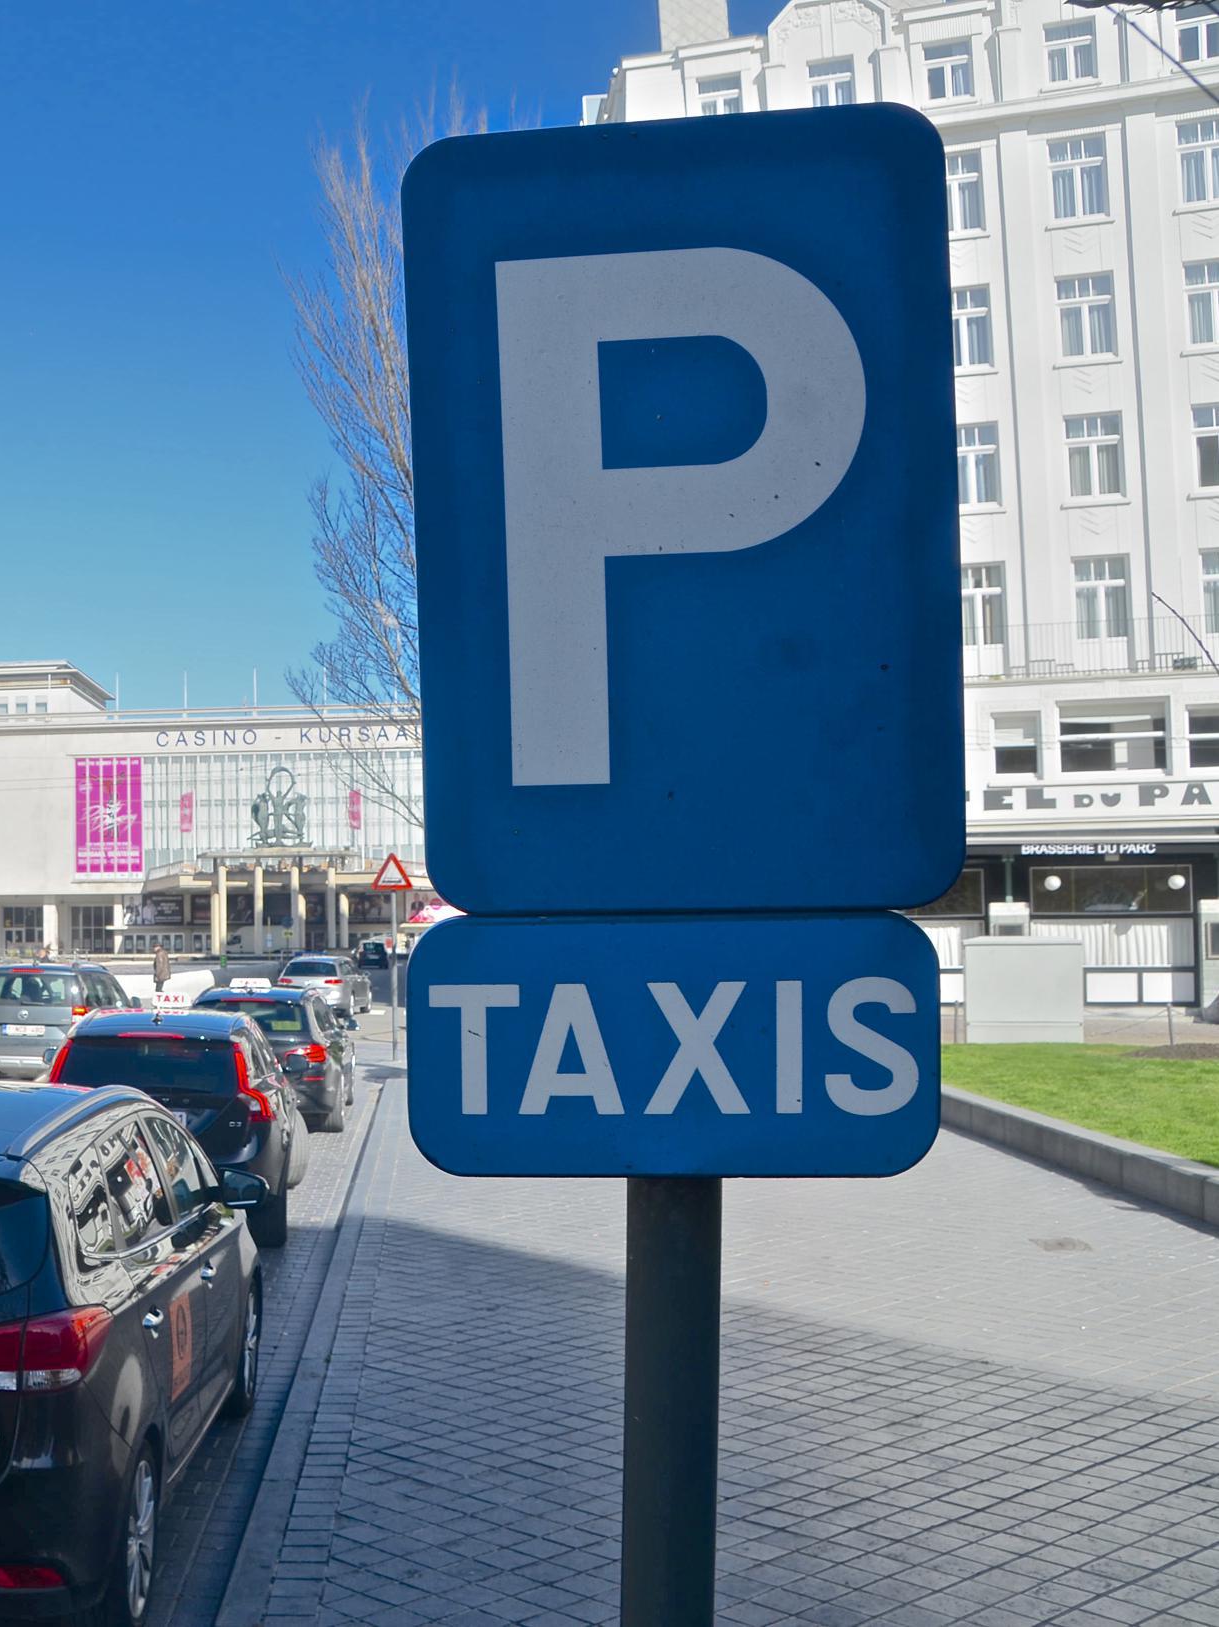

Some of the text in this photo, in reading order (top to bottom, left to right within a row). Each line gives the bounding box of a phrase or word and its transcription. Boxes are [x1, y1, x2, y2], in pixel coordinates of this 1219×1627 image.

[495, 247, 867, 786] P
[156, 728, 257, 747] CASINO
[1073, 792, 1121, 808] DU
[1021, 843, 1156, 855] BRASSERIE DU PARC
[157, 995, 184, 1003] TAXI
[428, 976, 919, 1117] TAXIS
